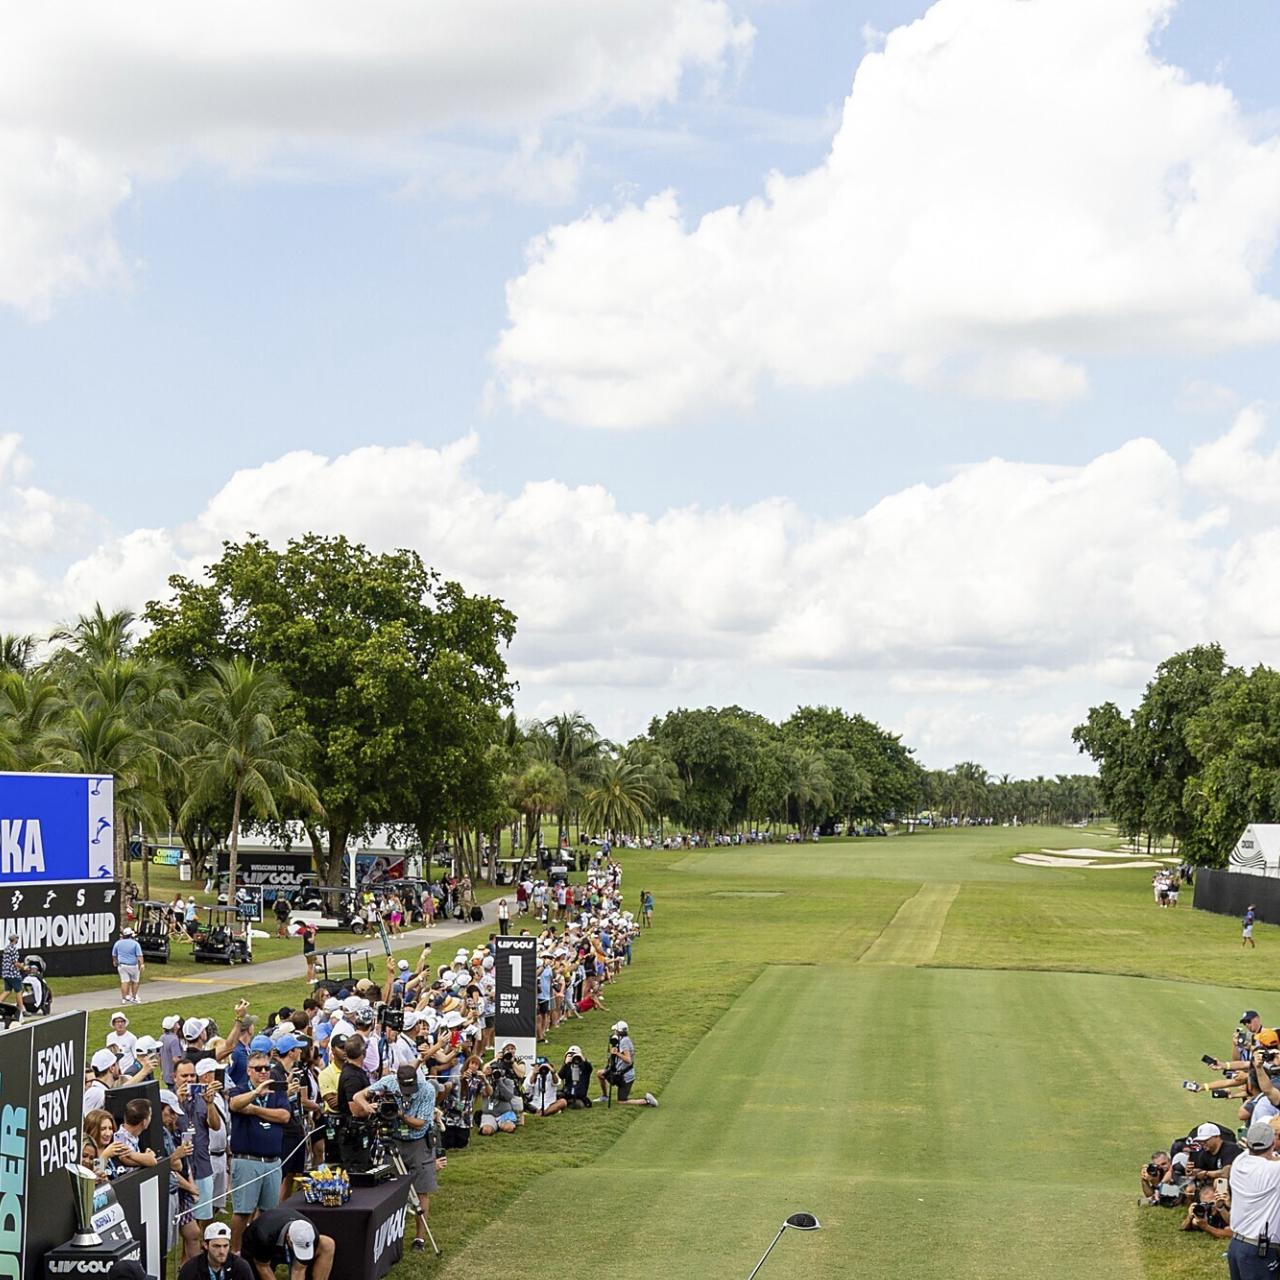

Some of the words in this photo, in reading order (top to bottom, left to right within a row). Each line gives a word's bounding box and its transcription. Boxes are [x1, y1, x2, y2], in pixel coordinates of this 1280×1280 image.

[250, 864, 274, 872] WELCOME
[276, 864, 285, 872] TO
[285, 864, 295, 872] THE
[508, 955, 522, 987] 1
